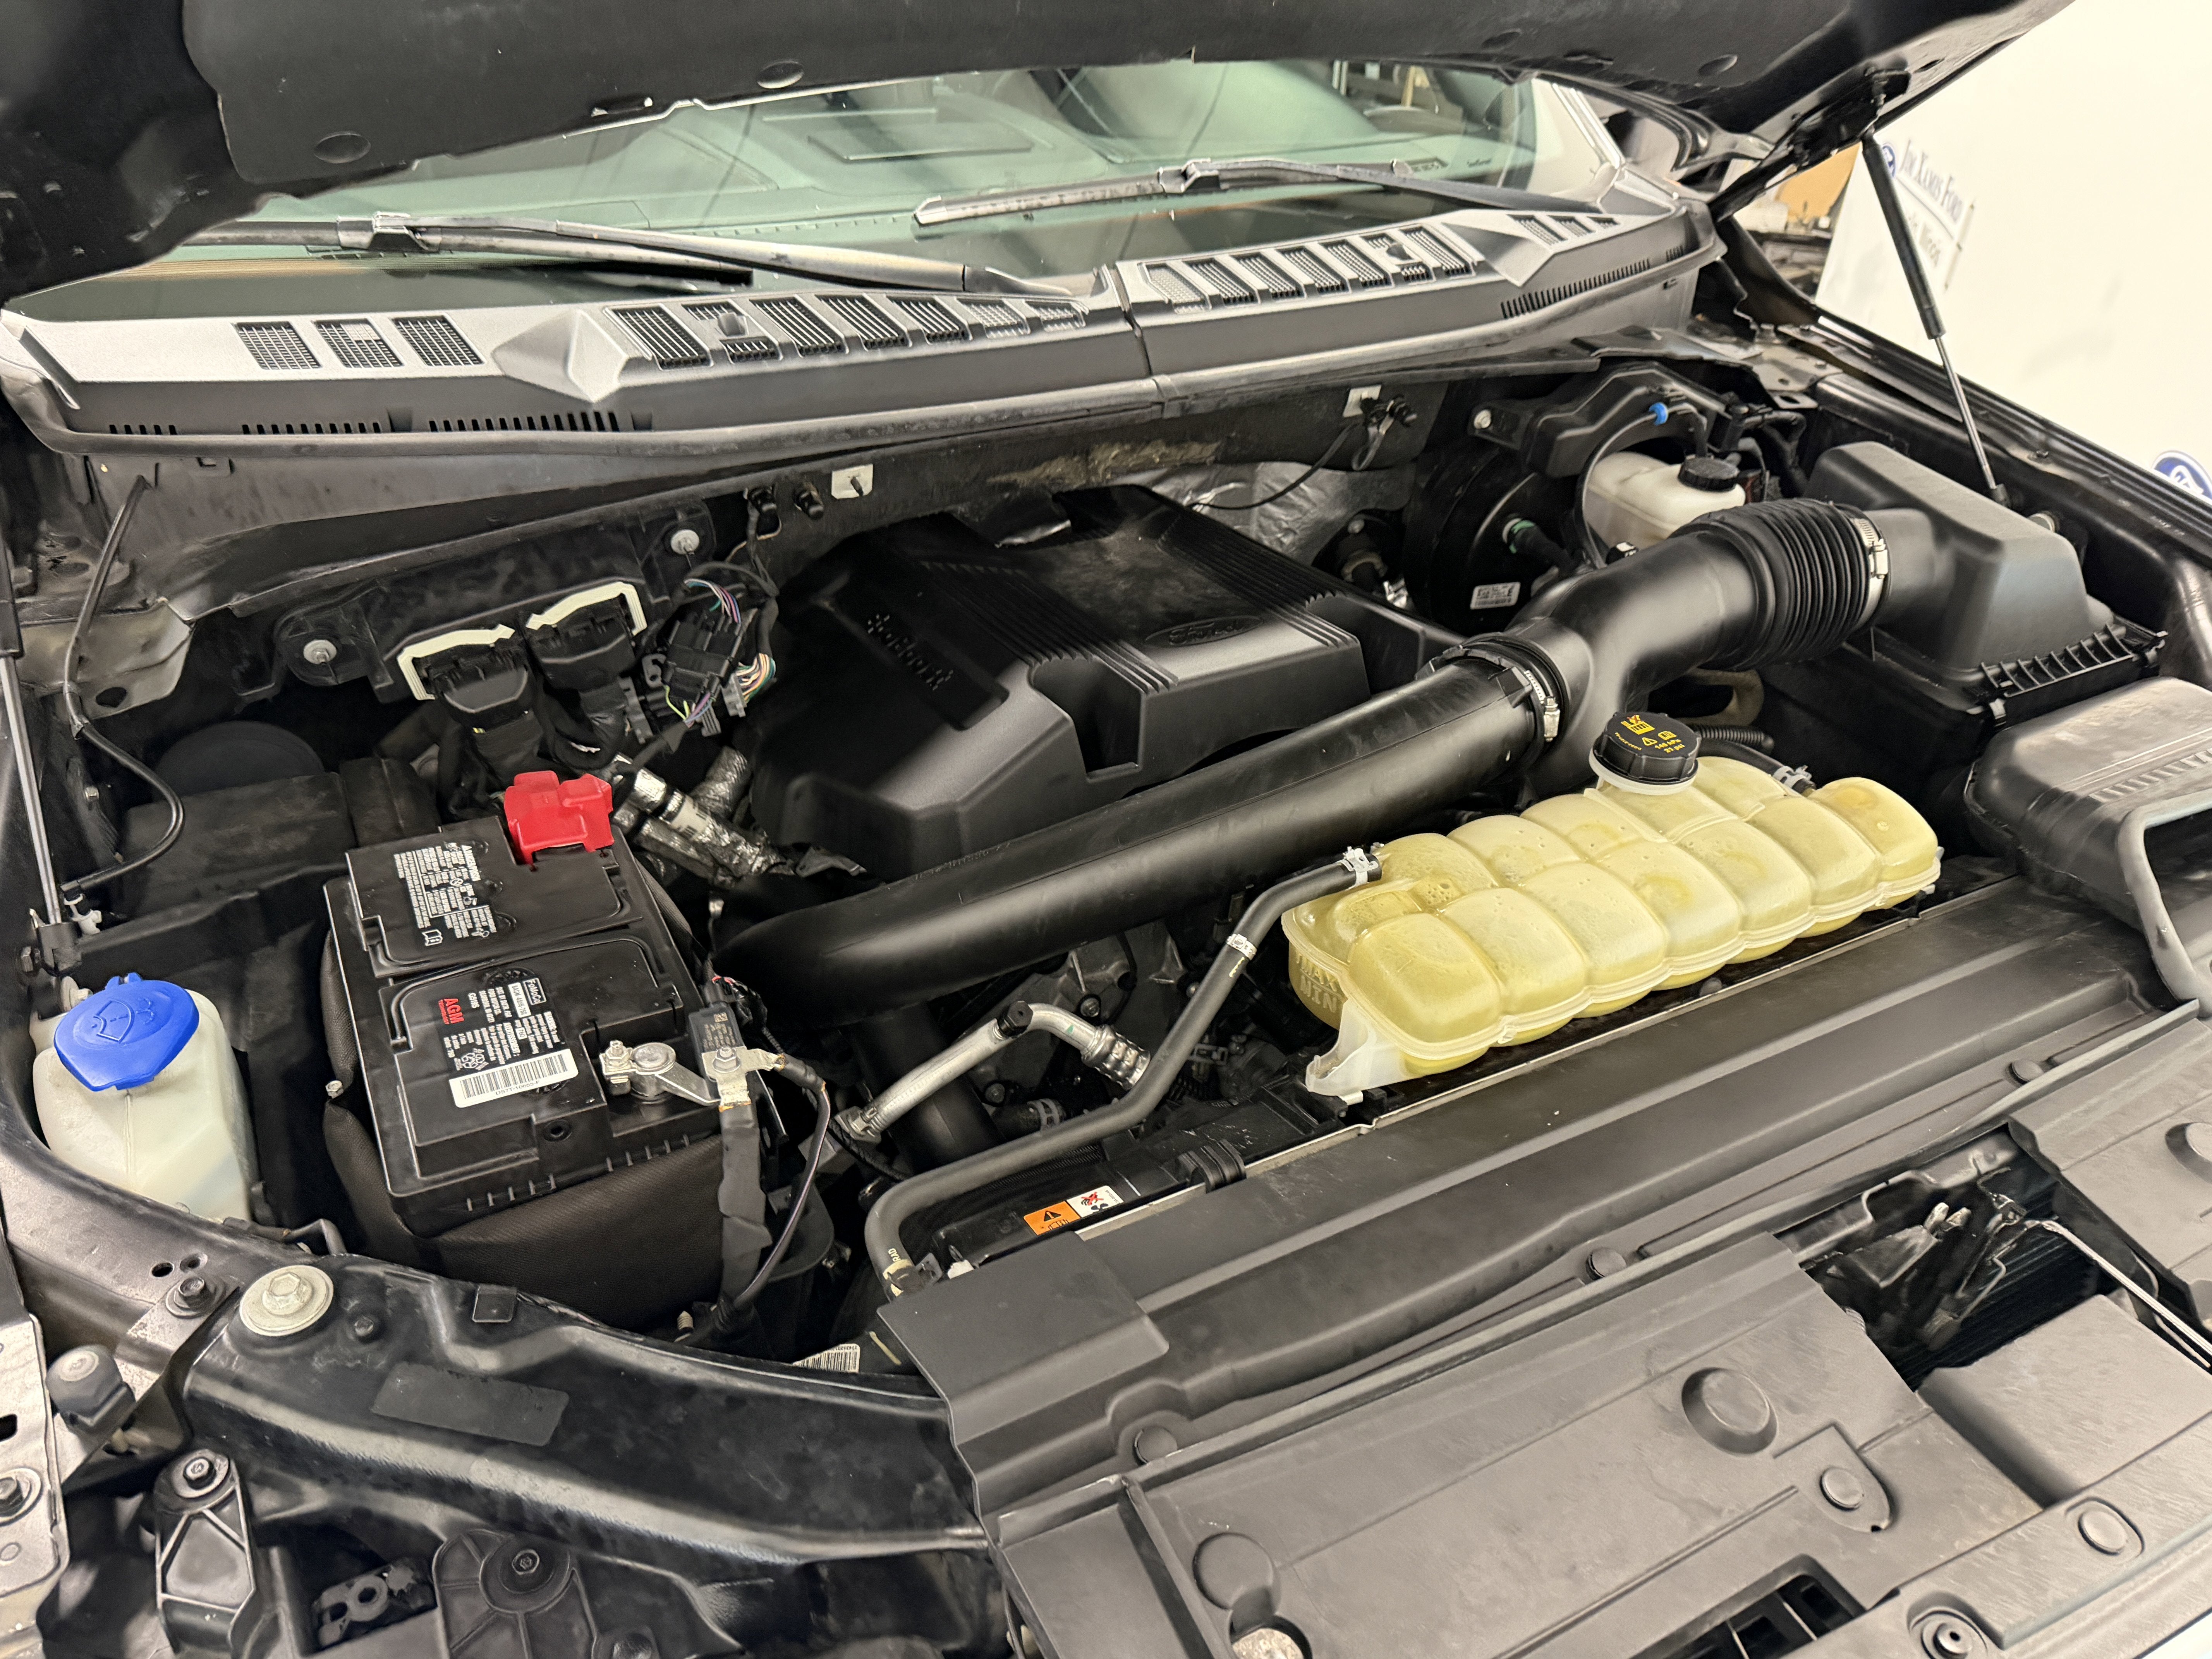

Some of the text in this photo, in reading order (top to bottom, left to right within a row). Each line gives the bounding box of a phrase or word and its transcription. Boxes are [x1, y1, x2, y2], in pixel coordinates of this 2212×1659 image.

[467, 992, 480, 1008] G519S
[526, 979, 542, 1003] FoMoCo
[1300, 975, 1337, 1013] MIN
[444, 996, 464, 1024] AGM
